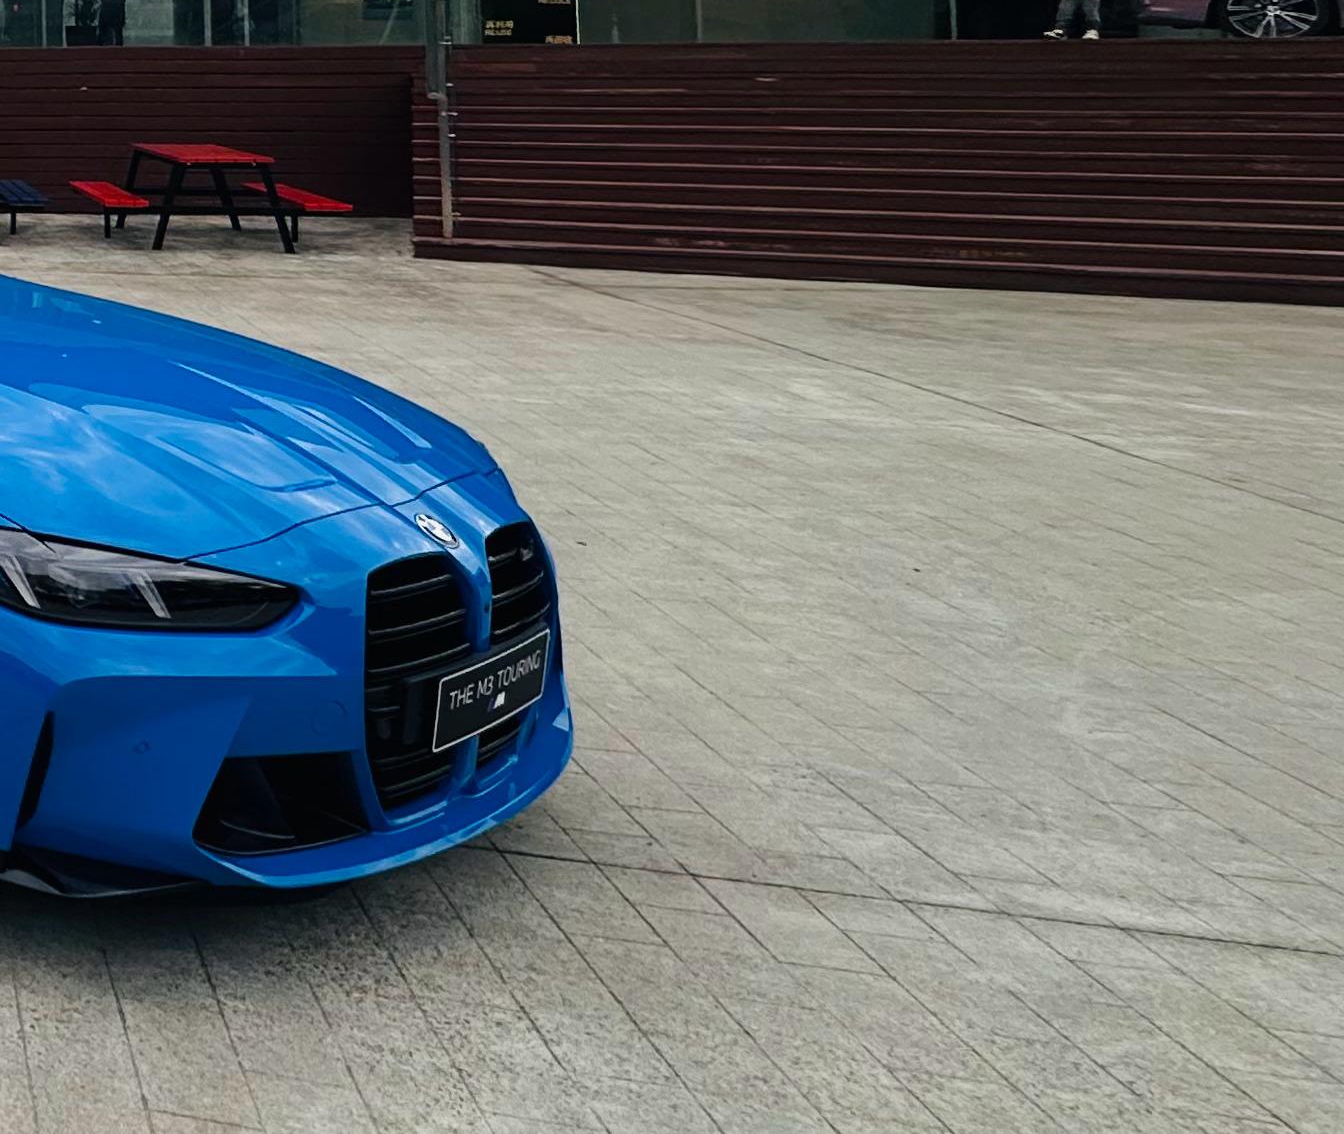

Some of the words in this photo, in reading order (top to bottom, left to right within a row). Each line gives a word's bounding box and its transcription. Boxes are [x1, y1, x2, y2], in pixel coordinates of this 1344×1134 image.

[449, 684, 475, 710] THE
[476, 675, 494, 699] M3
[497, 649, 541, 688] TOURING
